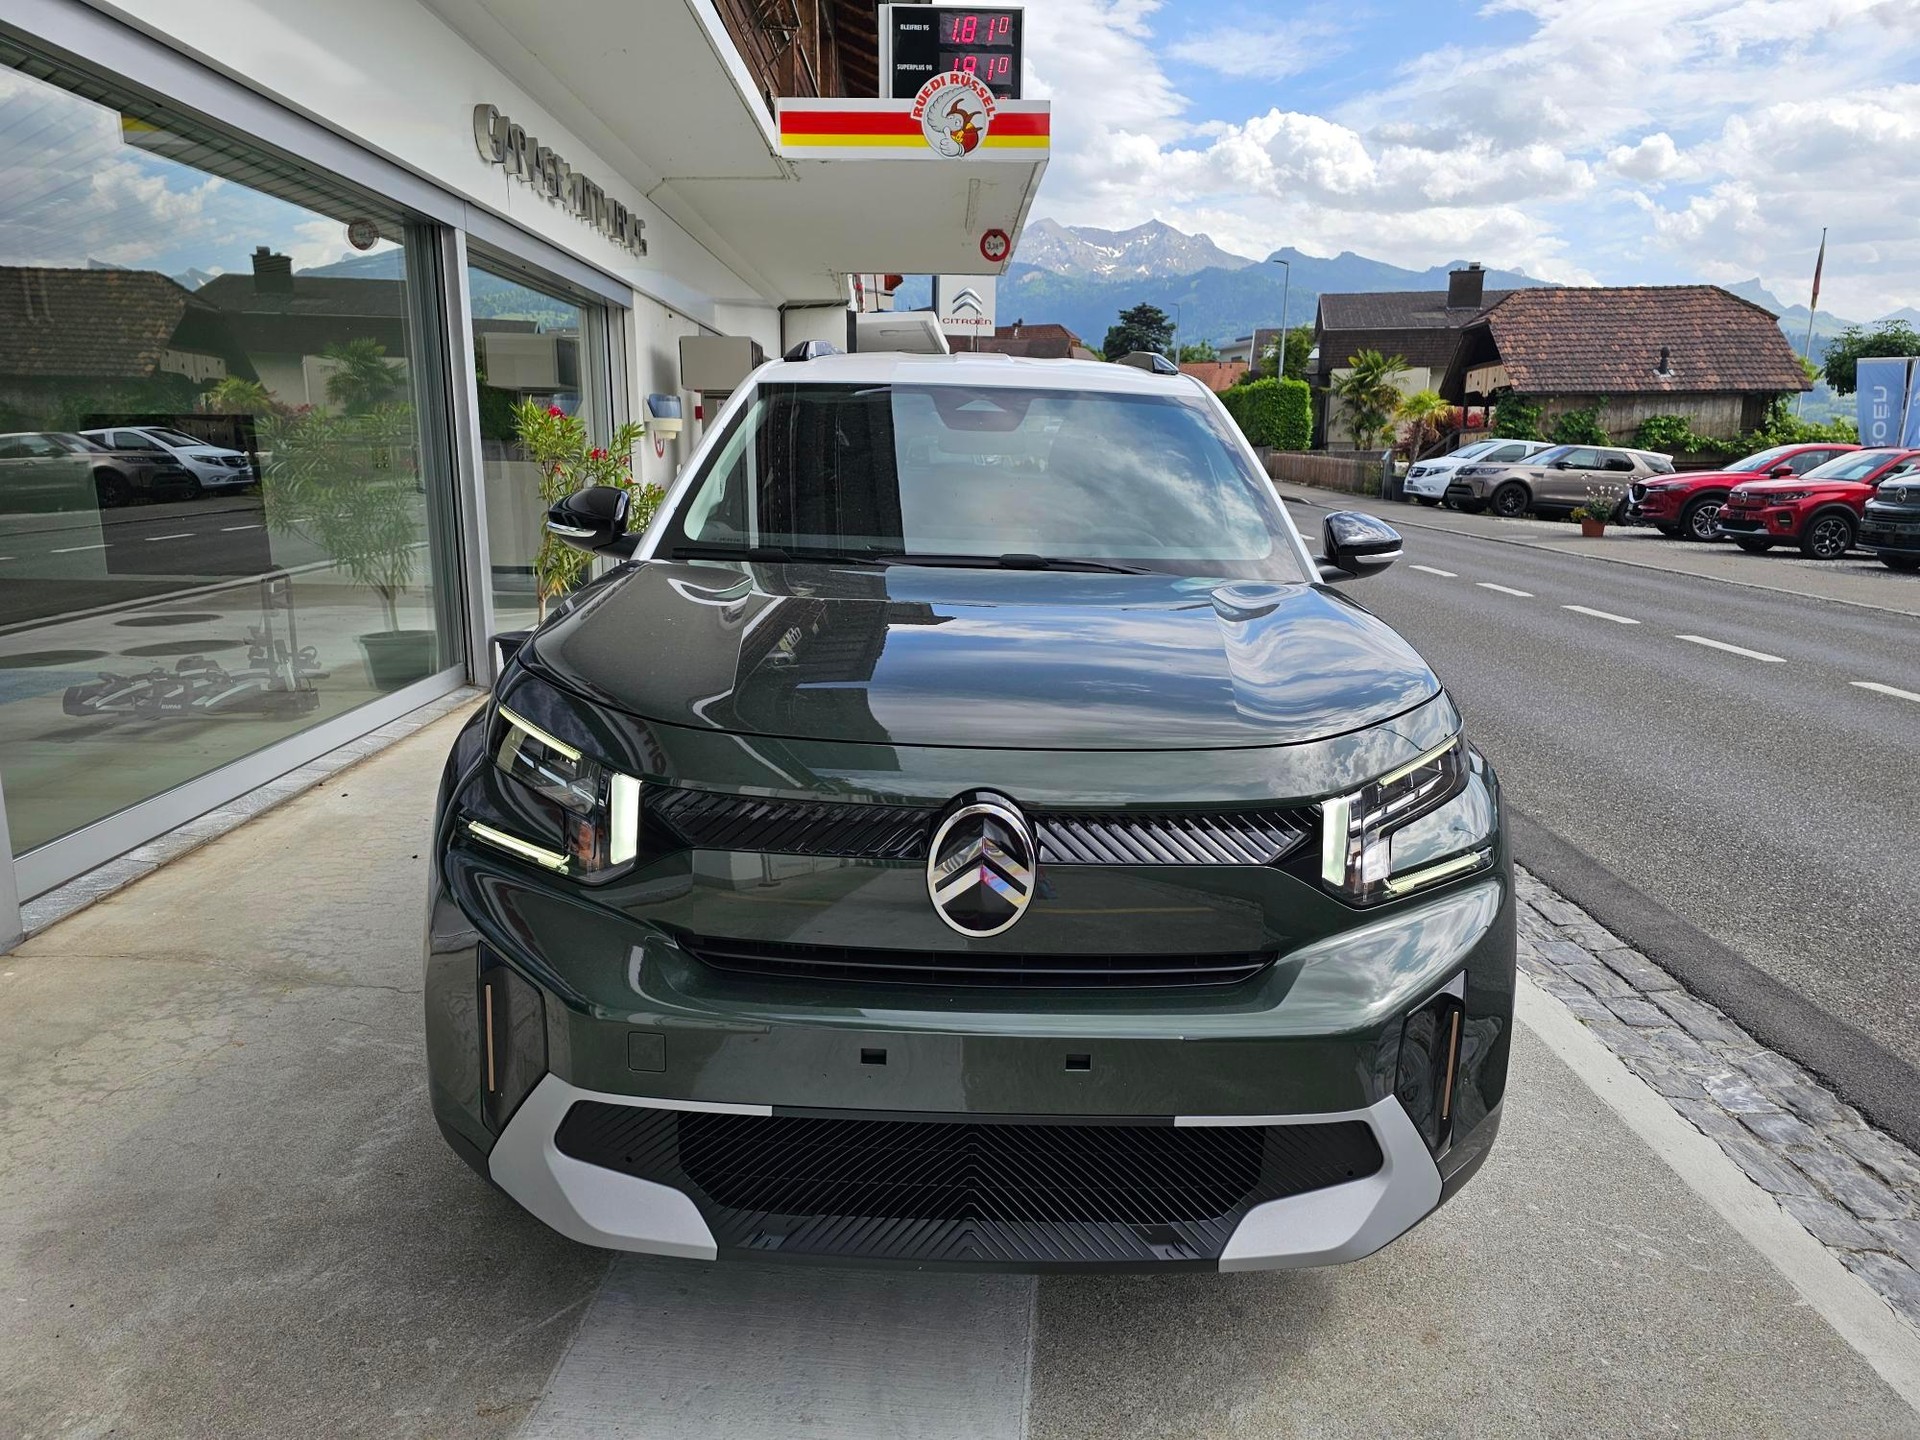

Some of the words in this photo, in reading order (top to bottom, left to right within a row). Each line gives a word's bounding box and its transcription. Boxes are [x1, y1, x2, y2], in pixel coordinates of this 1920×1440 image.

[900, 23, 922, 31] BLEIFREI
[922, 23, 930, 31] 95
[896, 63, 925, 71] SUPERPLUS
[912, 75, 947, 118] RUEDI
[949, 71, 996, 117] RÜSSEL
